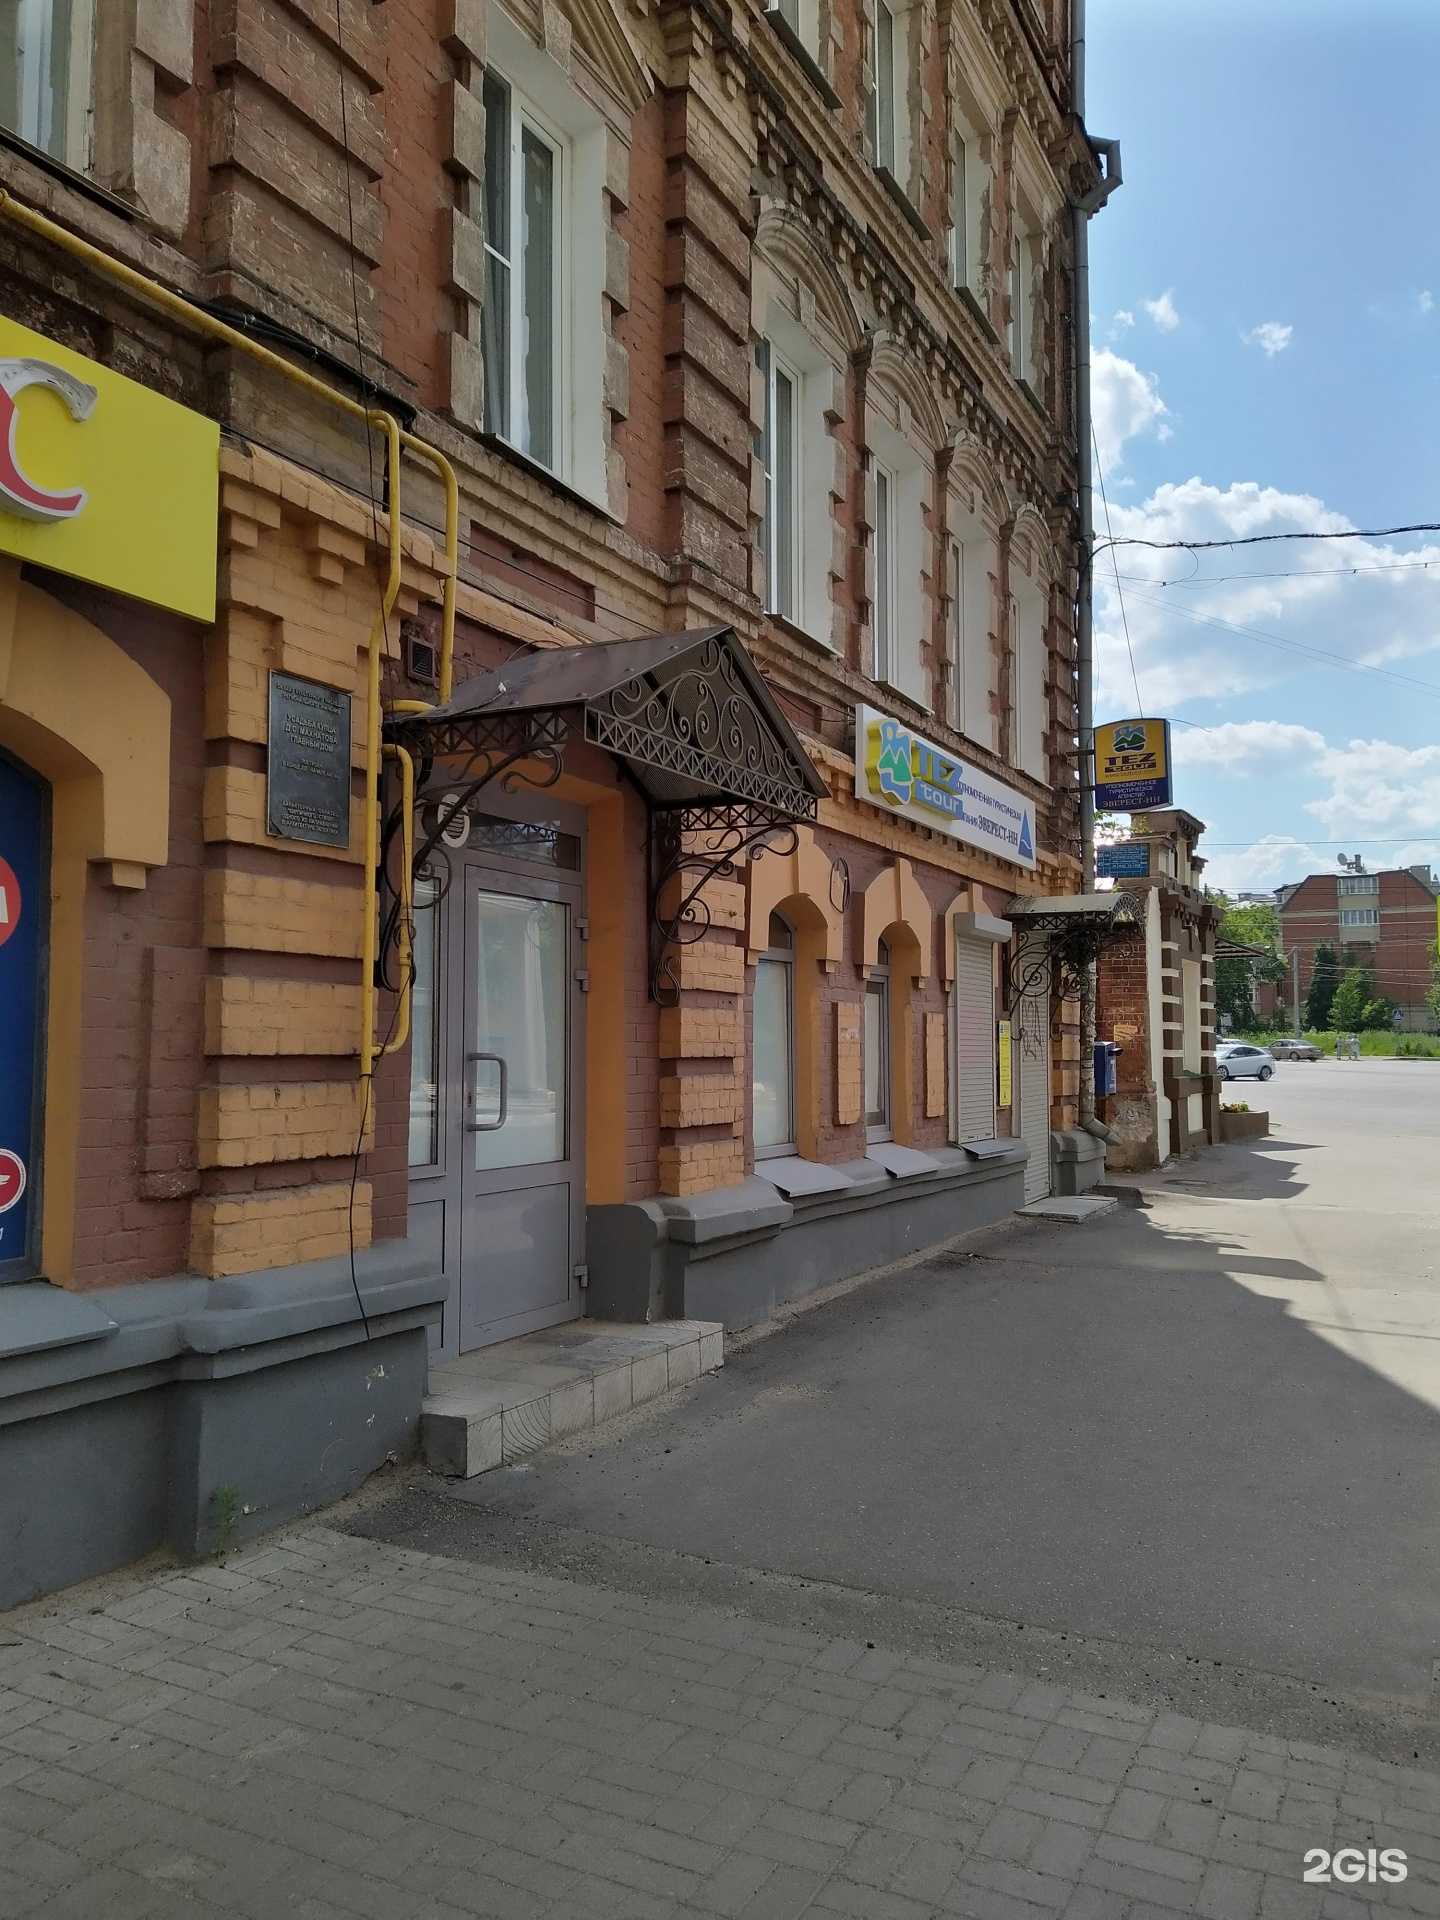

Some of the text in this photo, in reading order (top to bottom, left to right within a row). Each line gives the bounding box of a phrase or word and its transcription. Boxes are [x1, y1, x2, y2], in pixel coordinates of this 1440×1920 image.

[915, 740, 963, 795] TEZ
[1104, 752, 1156, 766] TEZ
[920, 783, 960, 815] tour
[978, 814, 1018, 847] ЭВЕРЕСТ-НН
